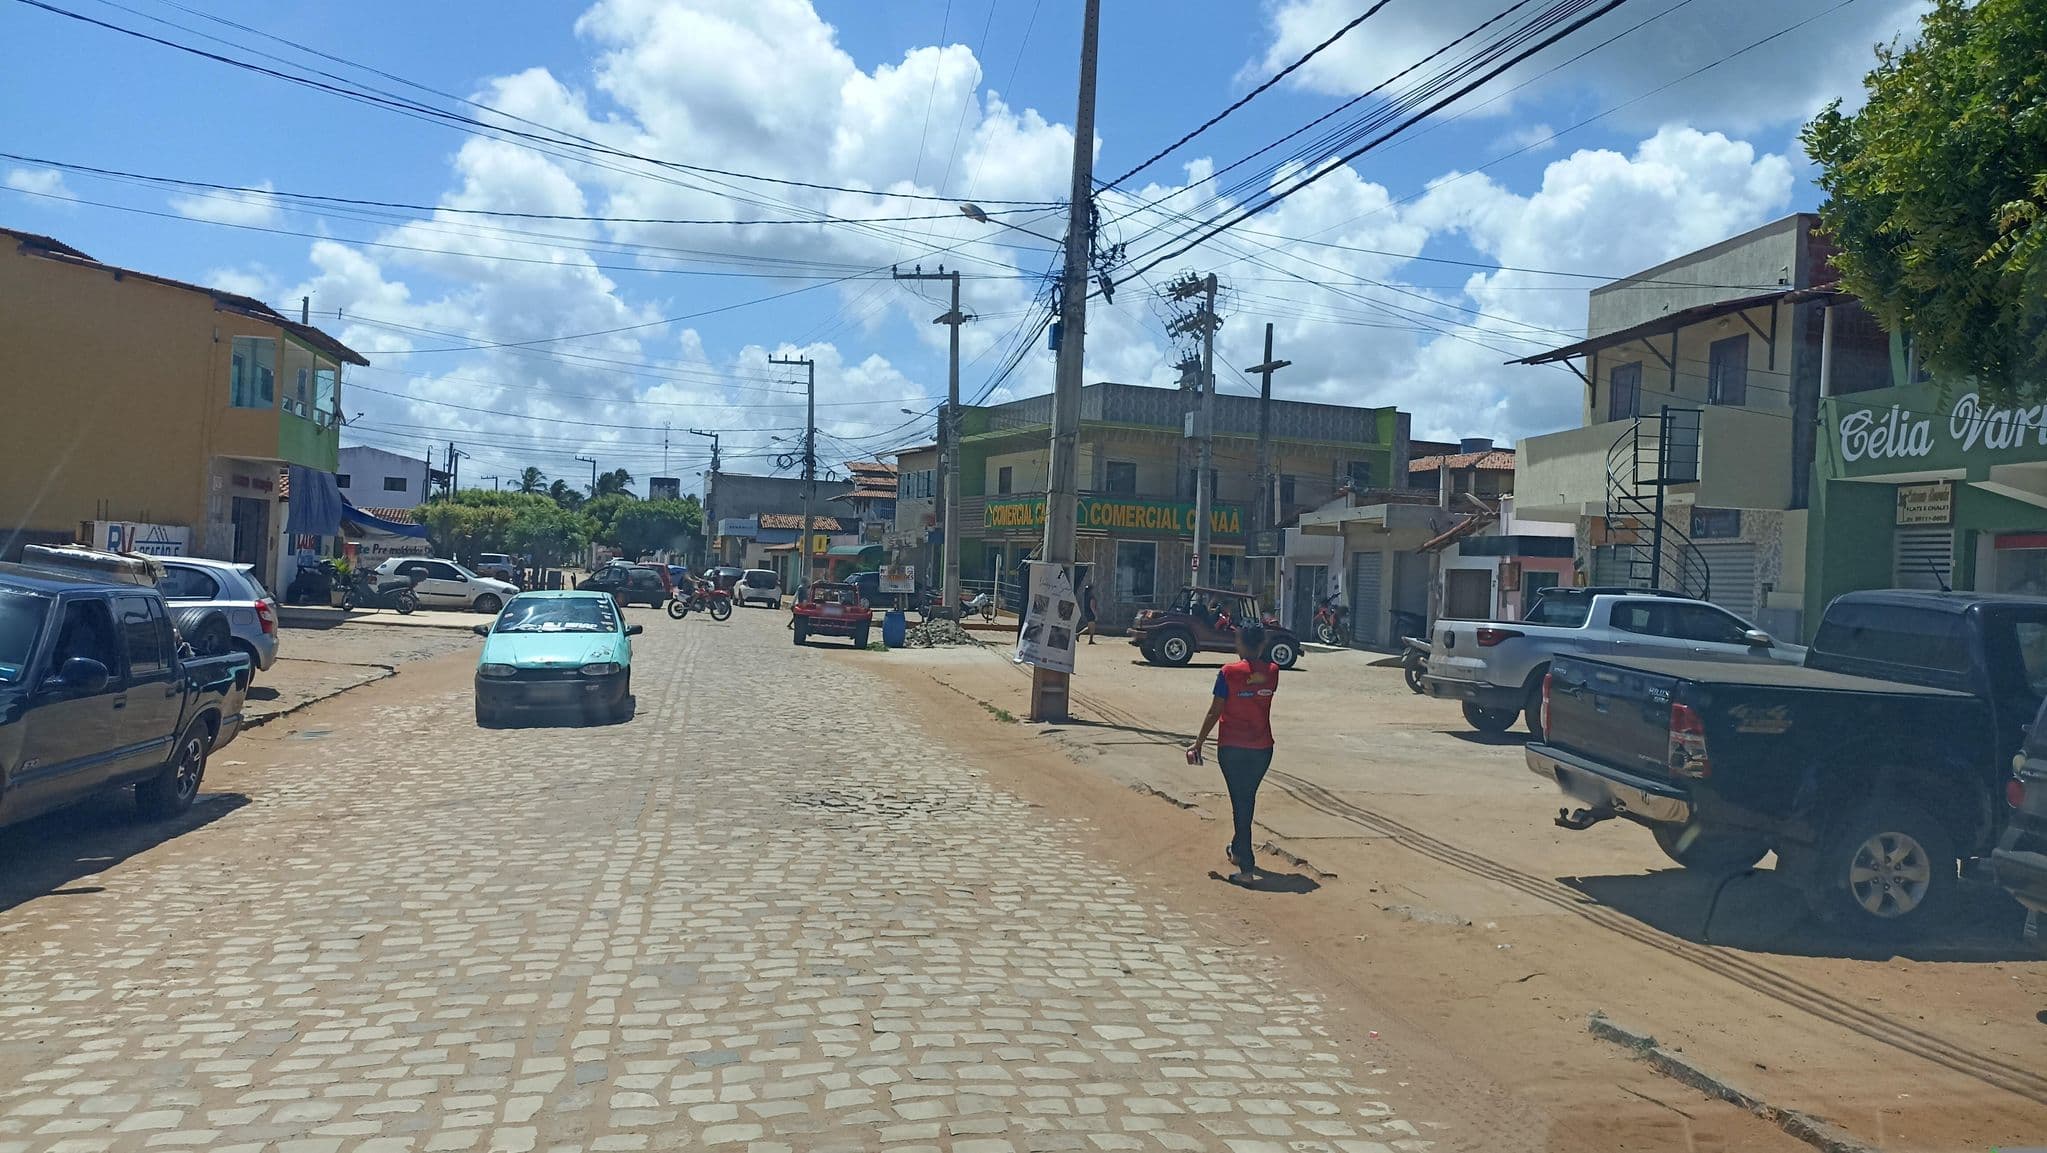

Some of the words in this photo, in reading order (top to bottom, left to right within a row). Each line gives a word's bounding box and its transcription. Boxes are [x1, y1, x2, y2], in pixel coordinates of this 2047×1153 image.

[1840, 404, 1934, 462] Célia
[992, 504, 1033, 526] COMERCIAL
[1090, 502, 1181, 530] COMERCIAL
[107, 525, 136, 553] RV
